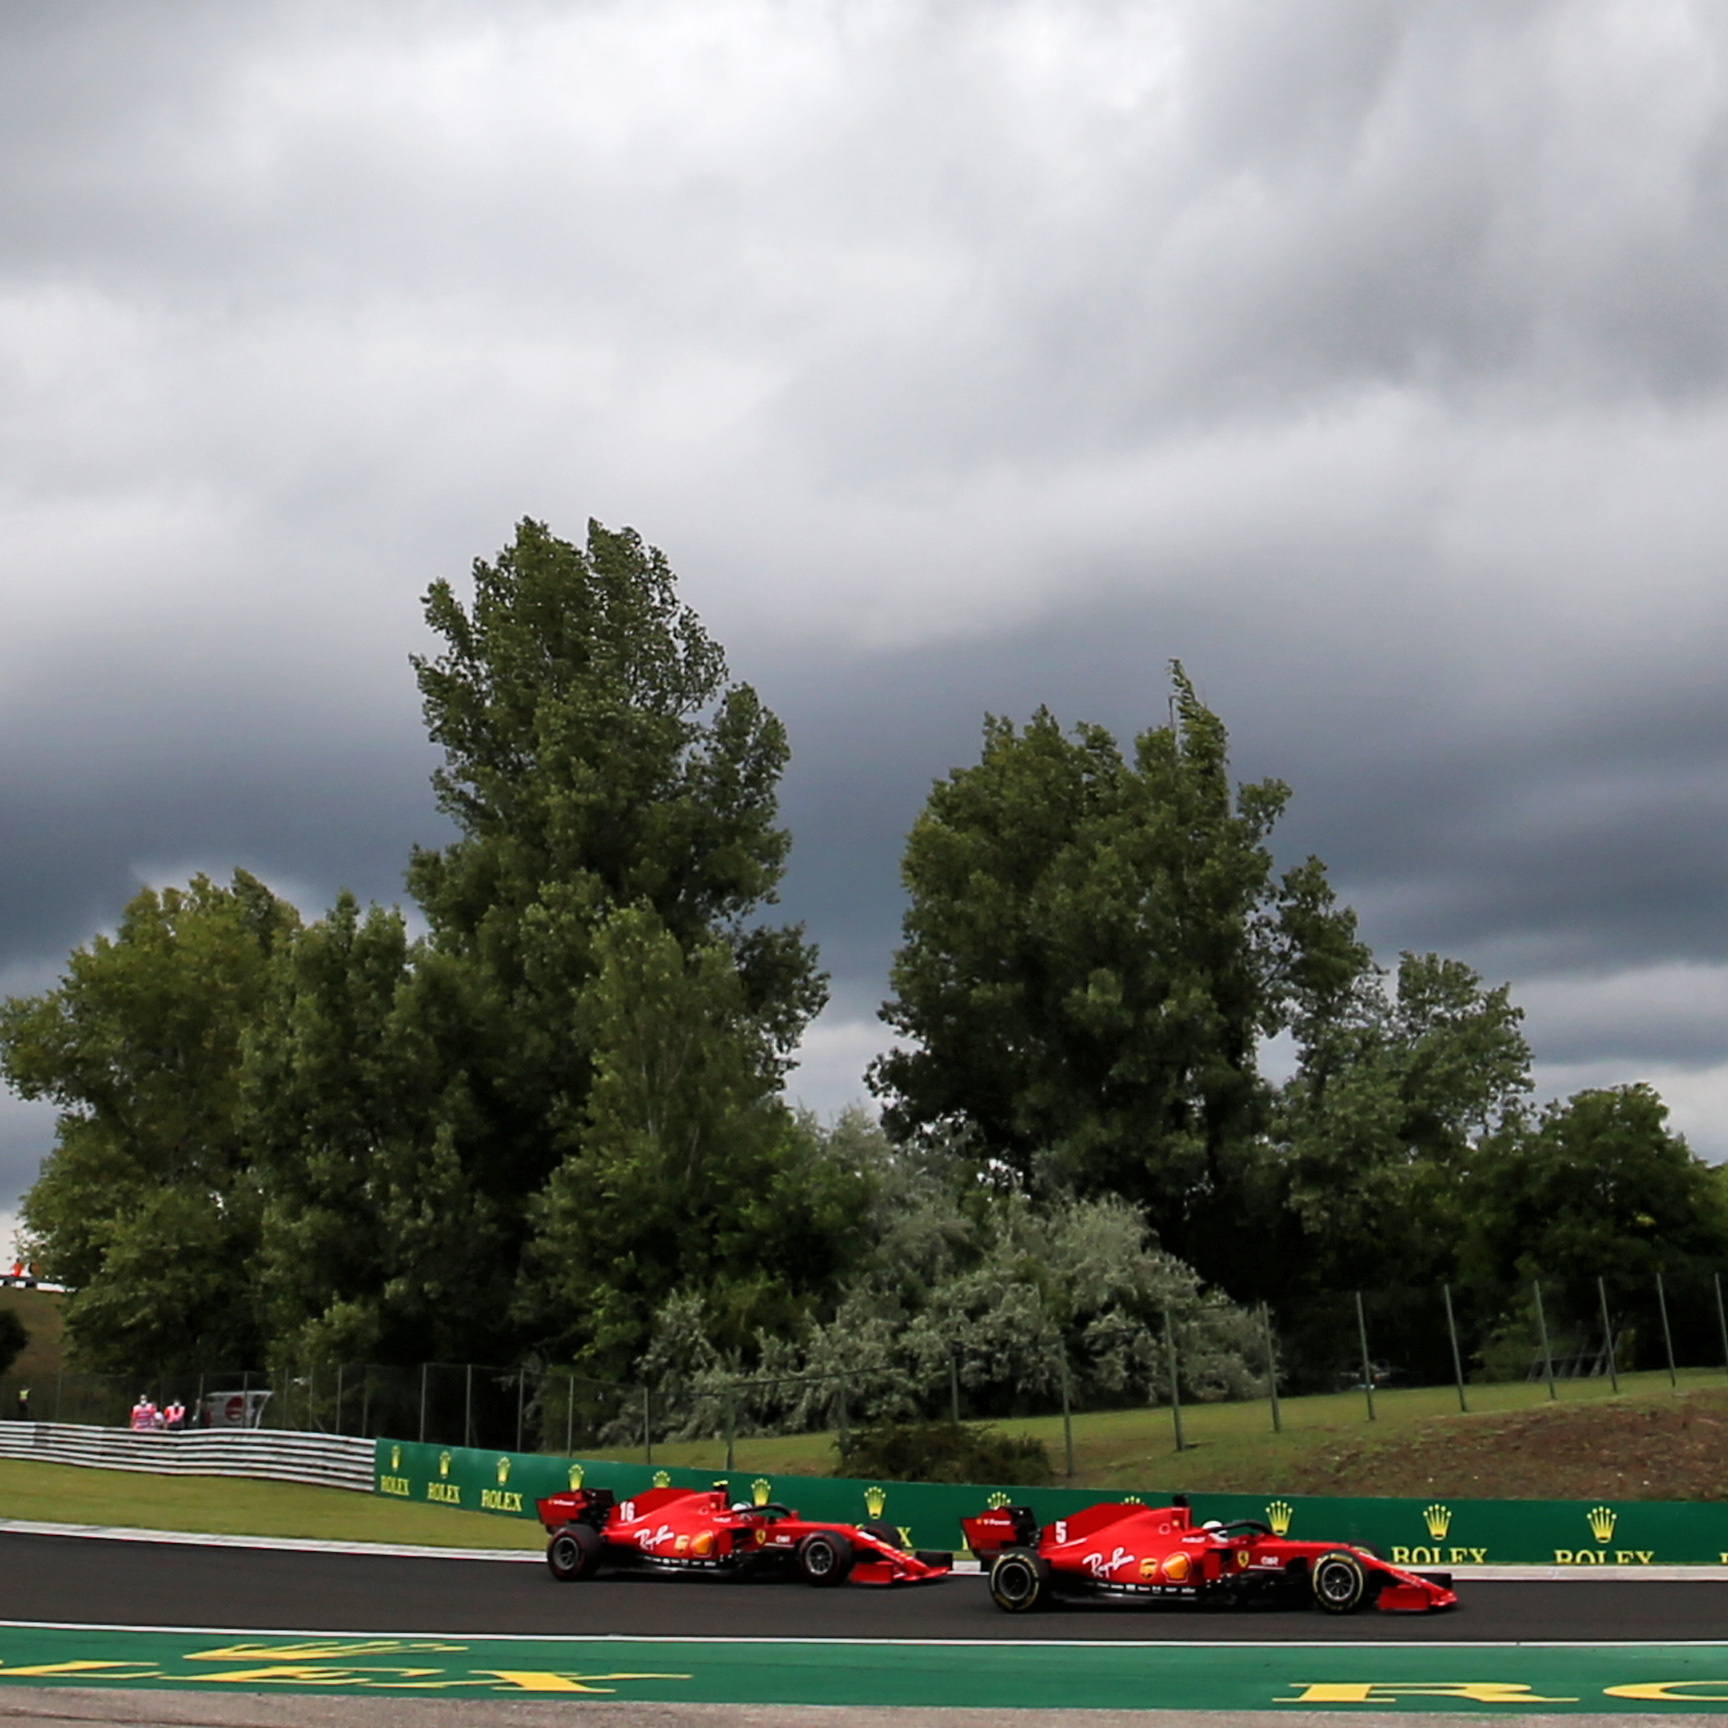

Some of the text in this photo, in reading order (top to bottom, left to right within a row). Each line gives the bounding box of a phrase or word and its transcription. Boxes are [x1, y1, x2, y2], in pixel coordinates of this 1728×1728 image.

[380, 1475, 410, 1496] ROLEX
[428, 1482, 461, 1504] ROLEX
[481, 1489, 522, 1512] ROLEX
[620, 1501, 635, 1522] 16
[1055, 1521, 1067, 1544] 5
[1391, 1546, 1488, 1564] ROLEX
